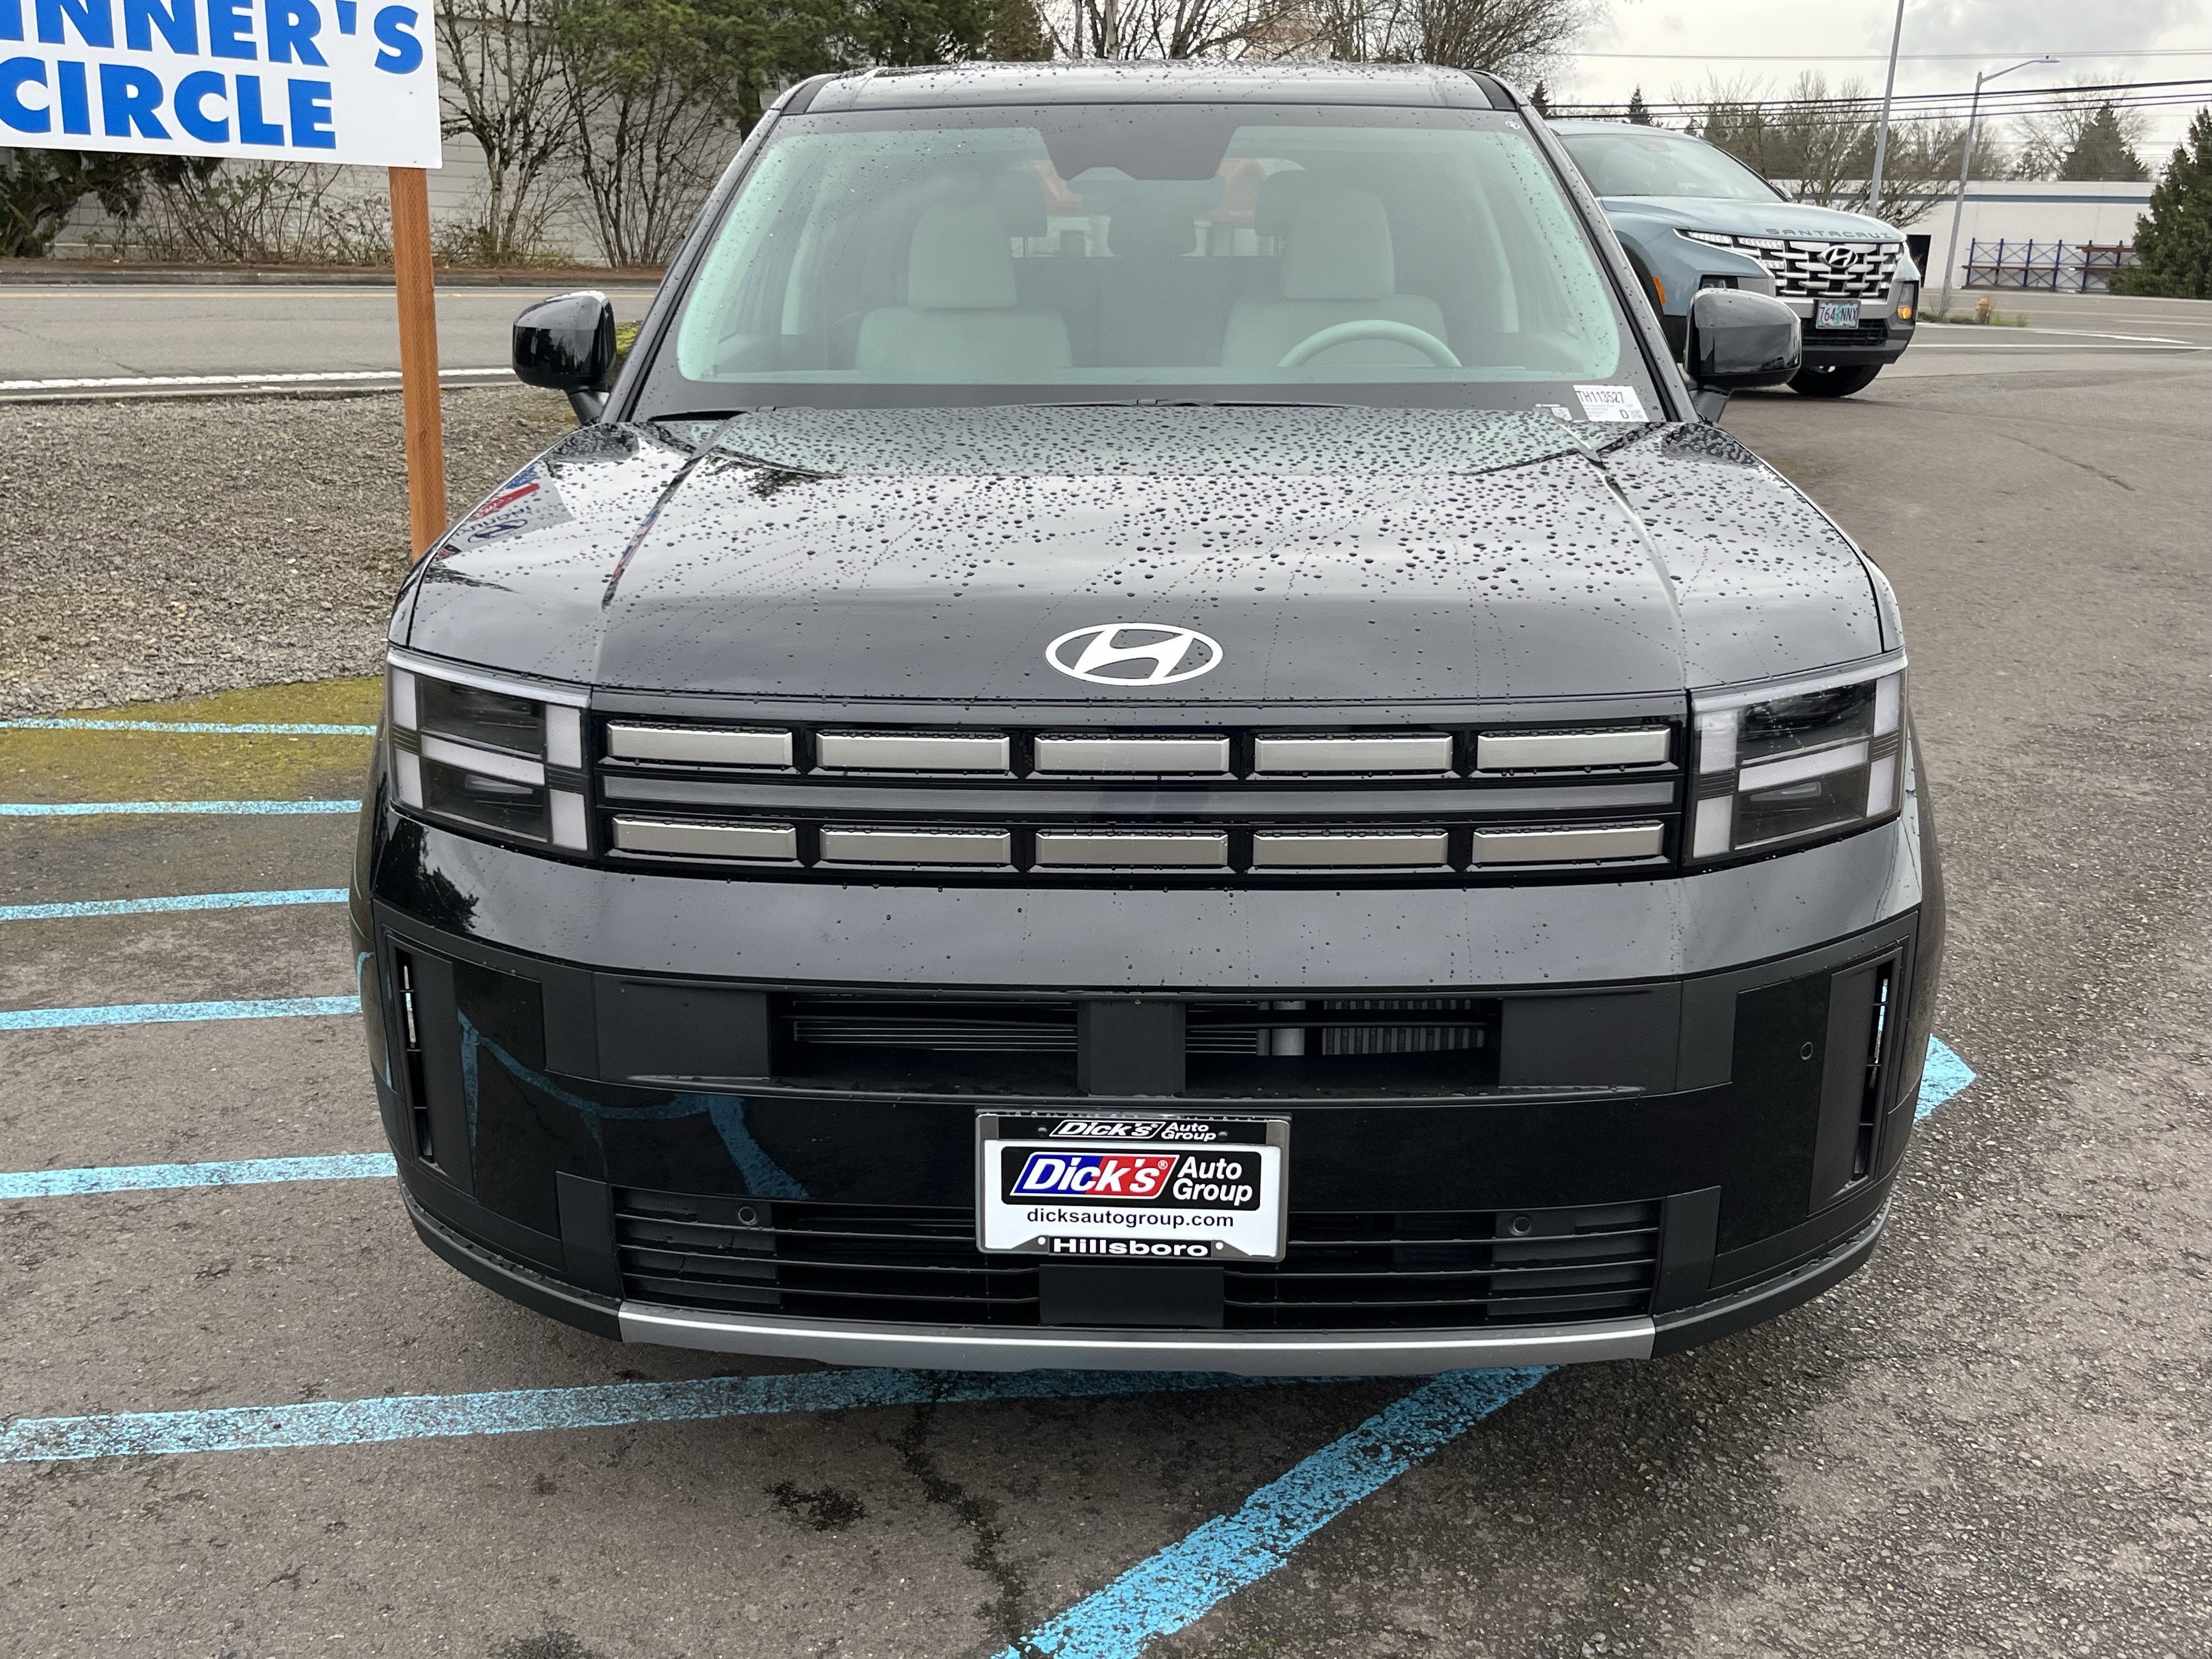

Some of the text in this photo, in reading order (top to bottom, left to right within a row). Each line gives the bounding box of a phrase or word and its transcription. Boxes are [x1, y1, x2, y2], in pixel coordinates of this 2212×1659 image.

[0, 57, 336, 149] CIRCLE
[1819, 307, 1835, 321] 764
[1576, 390, 1624, 404] TH113527
[1620, 409, 1629, 419] D
[1165, 1122, 1209, 1132] Auto
[1161, 1131, 1216, 1142] Group
[1178, 1156, 1242, 1180] Auto
[1172, 1178, 1252, 1206] Group
[1027, 1208, 1234, 1228] dicksautogroup.com
[1053, 1238, 1208, 1257] Hillsboro
